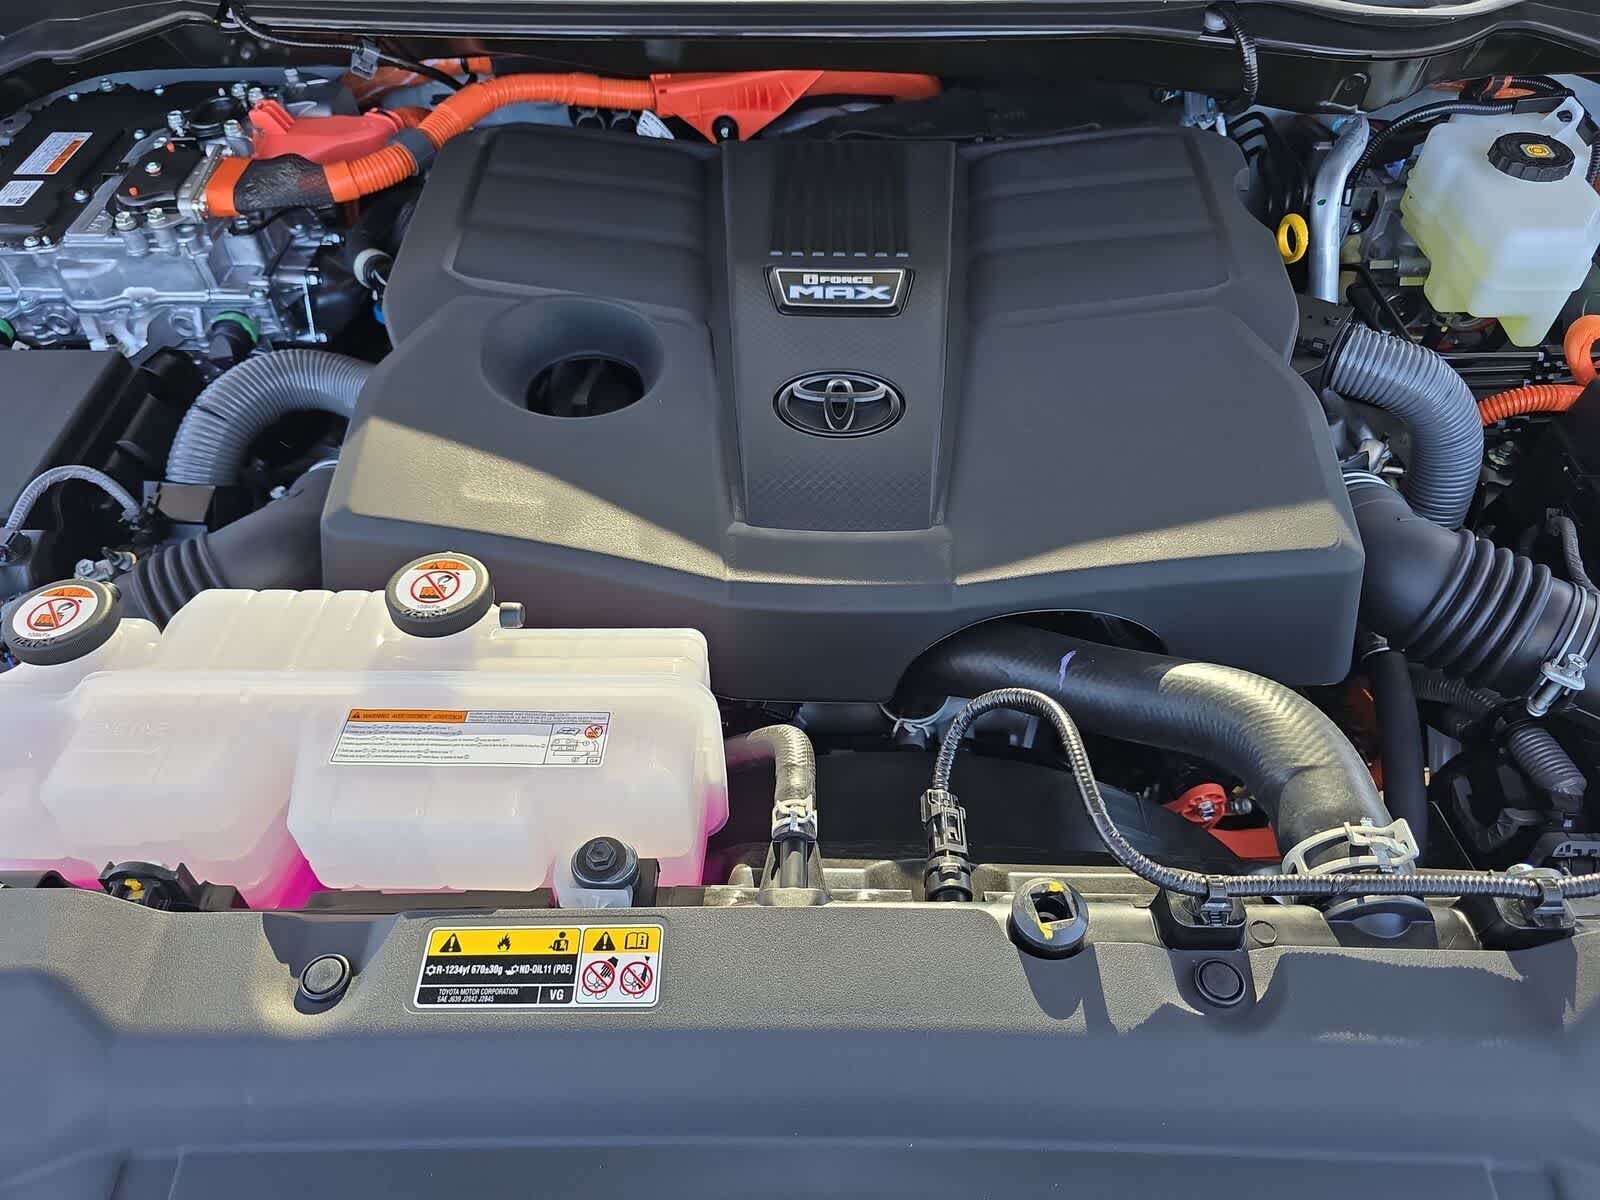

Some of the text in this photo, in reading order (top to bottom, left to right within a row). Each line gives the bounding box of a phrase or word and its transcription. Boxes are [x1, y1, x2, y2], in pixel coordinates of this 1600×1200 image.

[789, 285, 891, 300] MAX
[553, 963, 573, 975] (POE)
[439, 987, 519, 996] TOYOTA MOTOR CORPORATION
[549, 988, 565, 1001] VG
